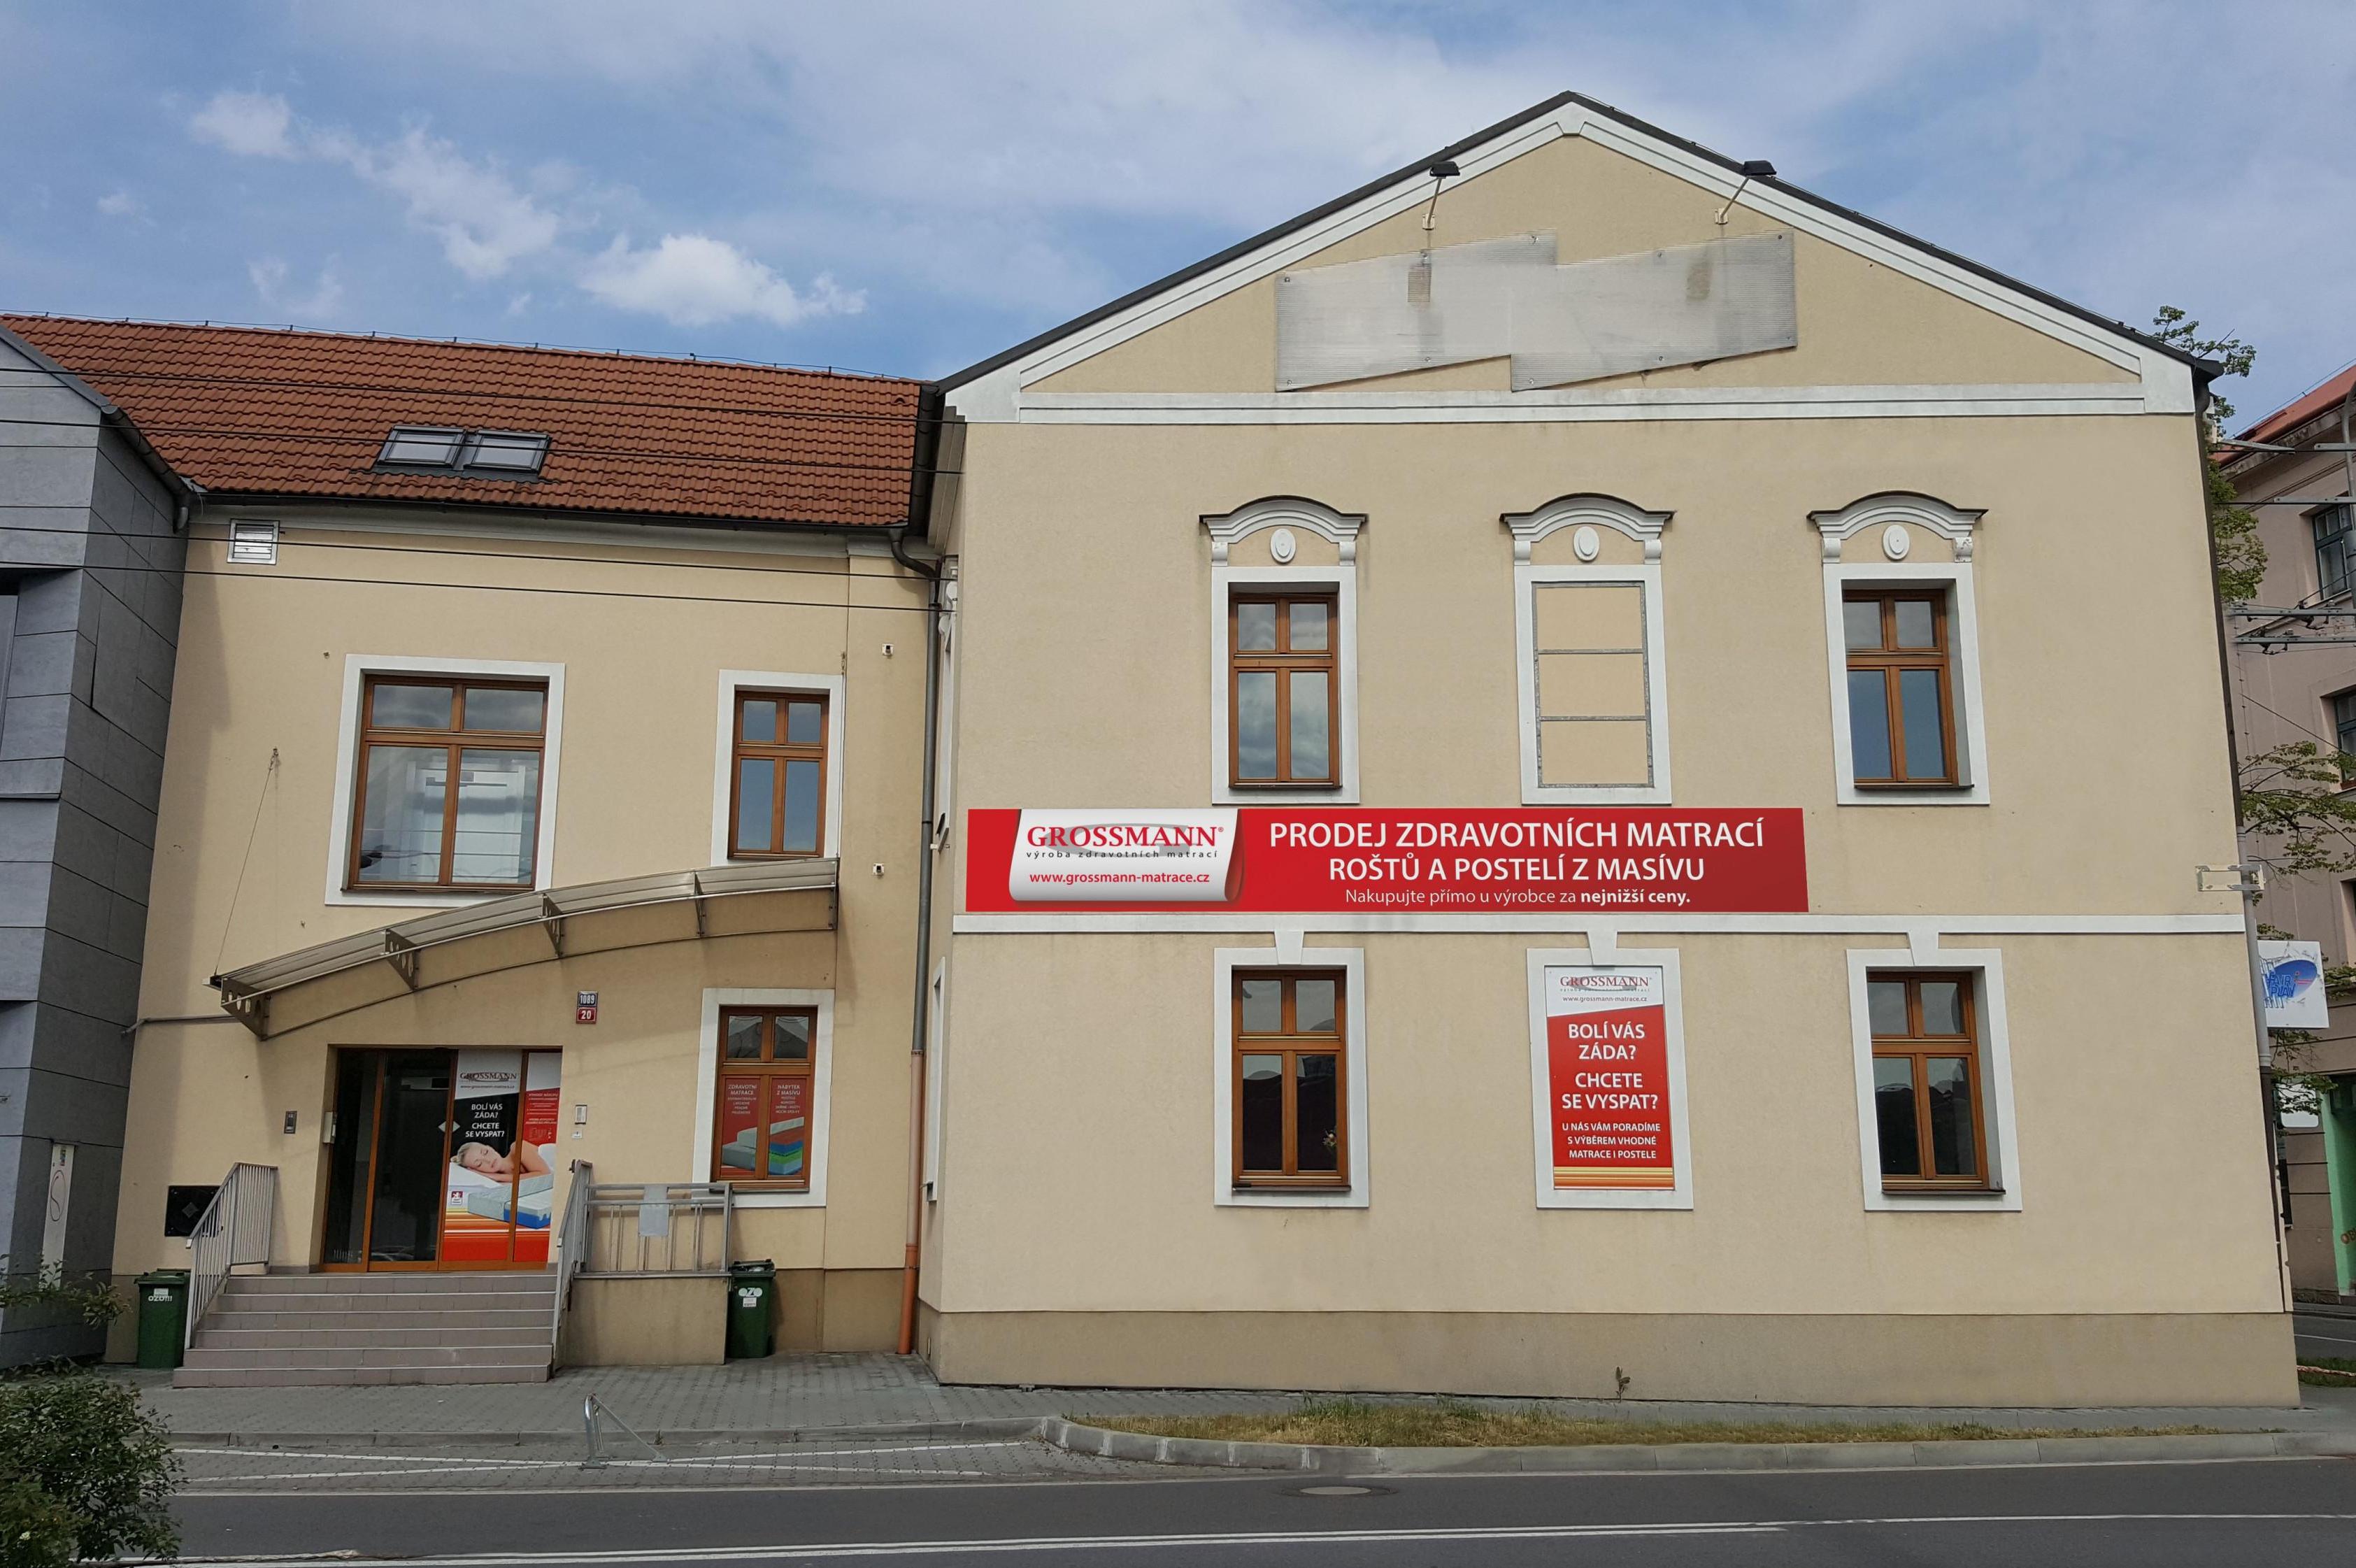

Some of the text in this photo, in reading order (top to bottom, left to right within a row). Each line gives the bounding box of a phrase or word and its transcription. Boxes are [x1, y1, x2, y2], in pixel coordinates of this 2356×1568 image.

[1271, 817, 1764, 848] PRODEJ ZDRAVOTNÍCH MATRACÍ
[1027, 850, 1071, 859] výroba
[1330, 852, 1704, 881] ROŠTŮ A POSTELÍ Z MASÍVU
[1029, 873, 1211, 885] www.grossmann-matrace.cz
[1347, 888, 1691, 906] Nakupujte přímo u výrobce za nejnižší ceny.
[580, 995, 595, 1004] 1089
[581, 1010, 592, 1020] 20
[1568, 1022, 1645, 1039] BOLÍ VÁS
[1578, 1043, 1636, 1060] ZÁDA?
[1575, 1072, 1643, 1088] CHCETE
[471, 1102, 503, 1111] BOLÍ VÁS
[1562, 1094, 1658, 1109] SE VYSPAT?
[1562, 1121, 1661, 1132] U NÁS VÁM PORADÍME
[1567, 1134, 1657, 1145] S VÝBĚREM VHODNÉ
[1569, 1150, 1611, 1159] MATRACE
[1618, 1150, 1657, 1159] POSTELE
